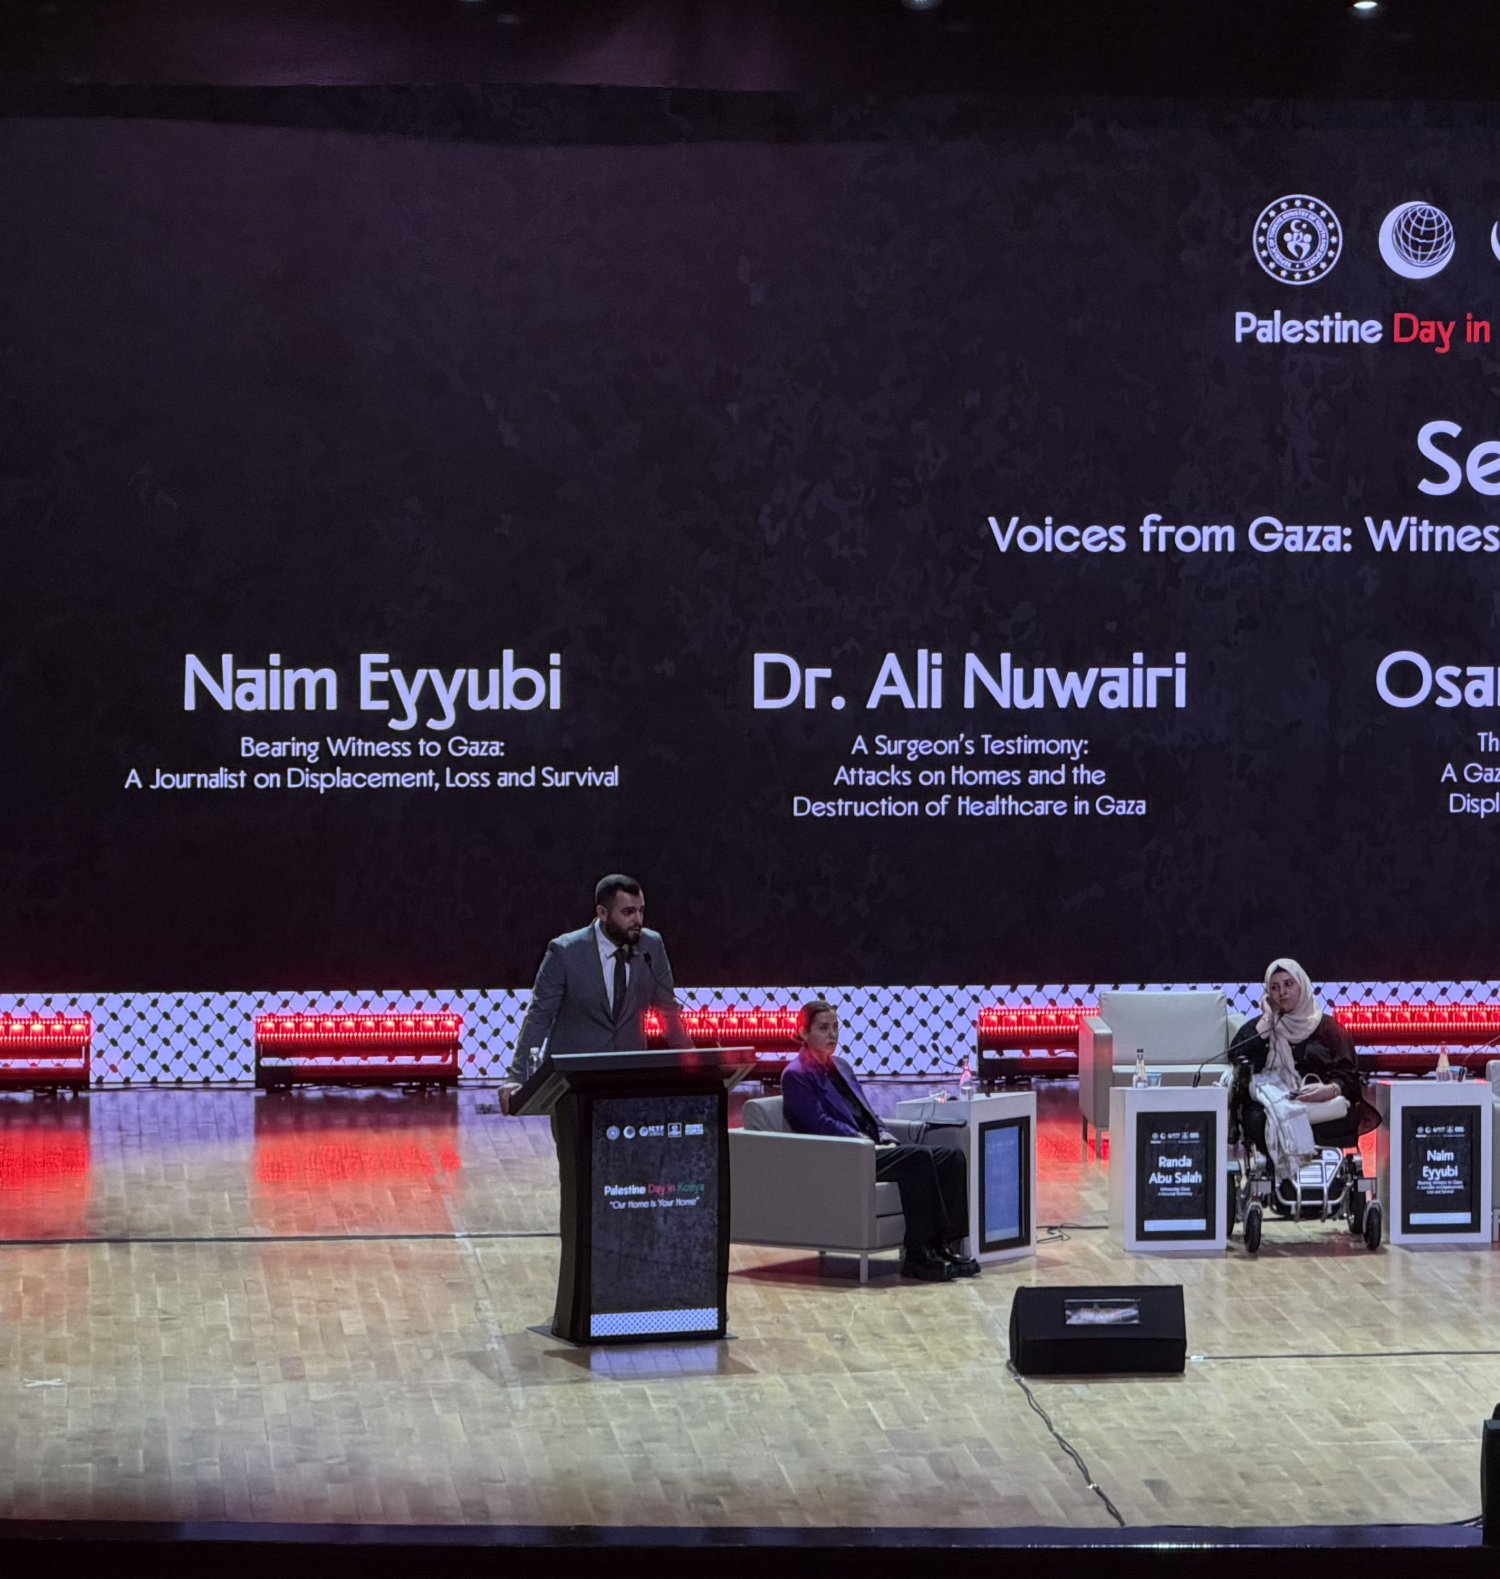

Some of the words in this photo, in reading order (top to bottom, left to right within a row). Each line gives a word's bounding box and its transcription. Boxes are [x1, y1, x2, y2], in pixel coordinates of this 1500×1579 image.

[1234, 308, 1384, 345] Palestine
[1393, 312, 1456, 354] Day
[1465, 312, 1492, 345] in
[987, 515, 1127, 553] Voices
[1138, 513, 1236, 553] from
[1247, 515, 1353, 553] Gaza:
[183, 653, 338, 712] Naim
[359, 648, 561, 731] Eyyubi
[753, 652, 846, 711] Dr.
[865, 648, 943, 710] Ali
[963, 651, 1187, 710] Nuwairi
[240, 736, 320, 764] Bearing
[325, 735, 413, 758] Witness
[417, 738, 442, 757] to
[447, 735, 505, 757] Gaza:
[850, 734, 869, 755] A
[874, 732, 976, 762] Surgeon’s
[980, 733, 1089, 761] Testimony:
[124, 768, 143, 789] A
[149, 766, 248, 790] Journalist
[253, 772, 282, 789] on
[286, 766, 441, 795] Displacement,
[445, 766, 491, 788] Loss
[496, 765, 536, 788] and
[541, 764, 619, 788] Survival
[833, 763, 913, 787] Attacks
[918, 770, 946, 786] on
[951, 764, 1022, 787] Homes
[1027, 763, 1066, 786] and
[1071, 763, 1107, 786] the
[1440, 762, 1458, 783] A
[793, 795, 919, 818] Destruction
[924, 793, 952, 817] of
[957, 794, 1068, 817] Healthcare
[1073, 794, 1090, 816] in
[1095, 794, 1147, 816] Gaza
[1158, 1155, 1192, 1168] Randa
[1426, 1149, 1454, 1162] Naim
[1148, 1172, 1172, 1185] Abu
[1174, 1171, 1202, 1184] Salah
[1422, 1165, 1458, 1180] Eyyubi
[604, 1184, 646, 1196] Palestine
[648, 1184, 665, 1197] Day
[657, 1198, 674, 1208] Your
